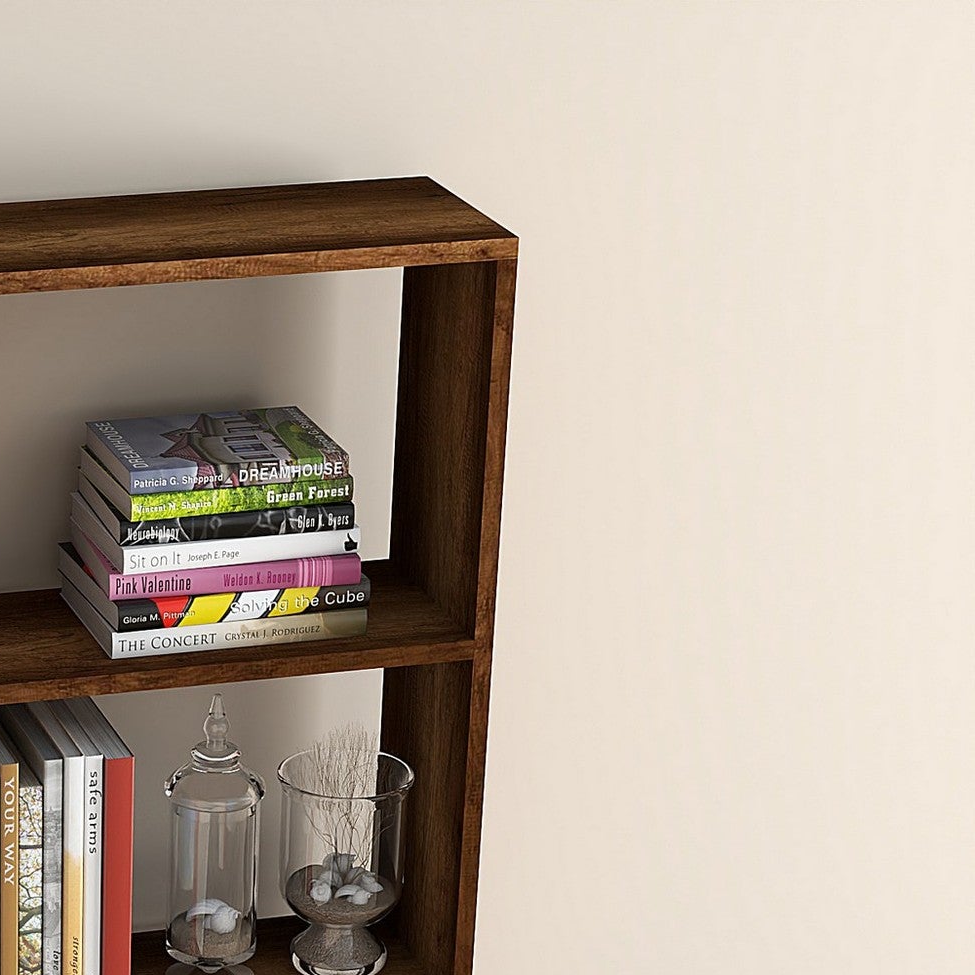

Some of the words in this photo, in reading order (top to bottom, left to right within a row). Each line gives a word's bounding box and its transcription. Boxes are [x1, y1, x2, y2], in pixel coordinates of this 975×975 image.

[134, 476, 166, 489] Patricia
[170, 476, 179, 486] G.
[182, 473, 222, 487] Sheppard
[239, 462, 343, 483] DREAMHOUSE
[136, 502, 166, 514] Vincent
[181, 500, 212, 512] Shapiro
[267, 488, 303, 503] Green
[308, 485, 349, 499] Forest
[127, 525, 180, 541] Neurobiology
[297, 515, 315, 528] Glen
[328, 514, 349, 528] Byers
[129, 553, 148, 569] Sit
[151, 555, 166, 567] on
[173, 552, 180, 565] It
[188, 552, 212, 563] Joseph
[222, 550, 239, 561] Page
[115, 576, 139, 595] Pink
[141, 574, 191, 593] Valentine
[224, 573, 253, 587] Weldon
[267, 571, 296, 585] Rooney
[123, 614, 147, 624] Gloria
[149, 613, 160, 622] M.
[163, 609, 195, 621] Pittman
[230, 599, 288, 614] Solving
[295, 595, 319, 608] the
[325, 590, 365, 606] Cube
[118, 640, 145, 652] THE
[152, 632, 216, 650] CONCERT
[225, 629, 260, 640] CRYSTAL
[272, 625, 320, 637] RODRIGUEZ
[88, 771, 102, 806] safe
[4, 776, 15, 837] YOUR
[88, 812, 99, 854] arms
[5, 843, 15, 886] WAY
[52, 950, 61, 970] love
